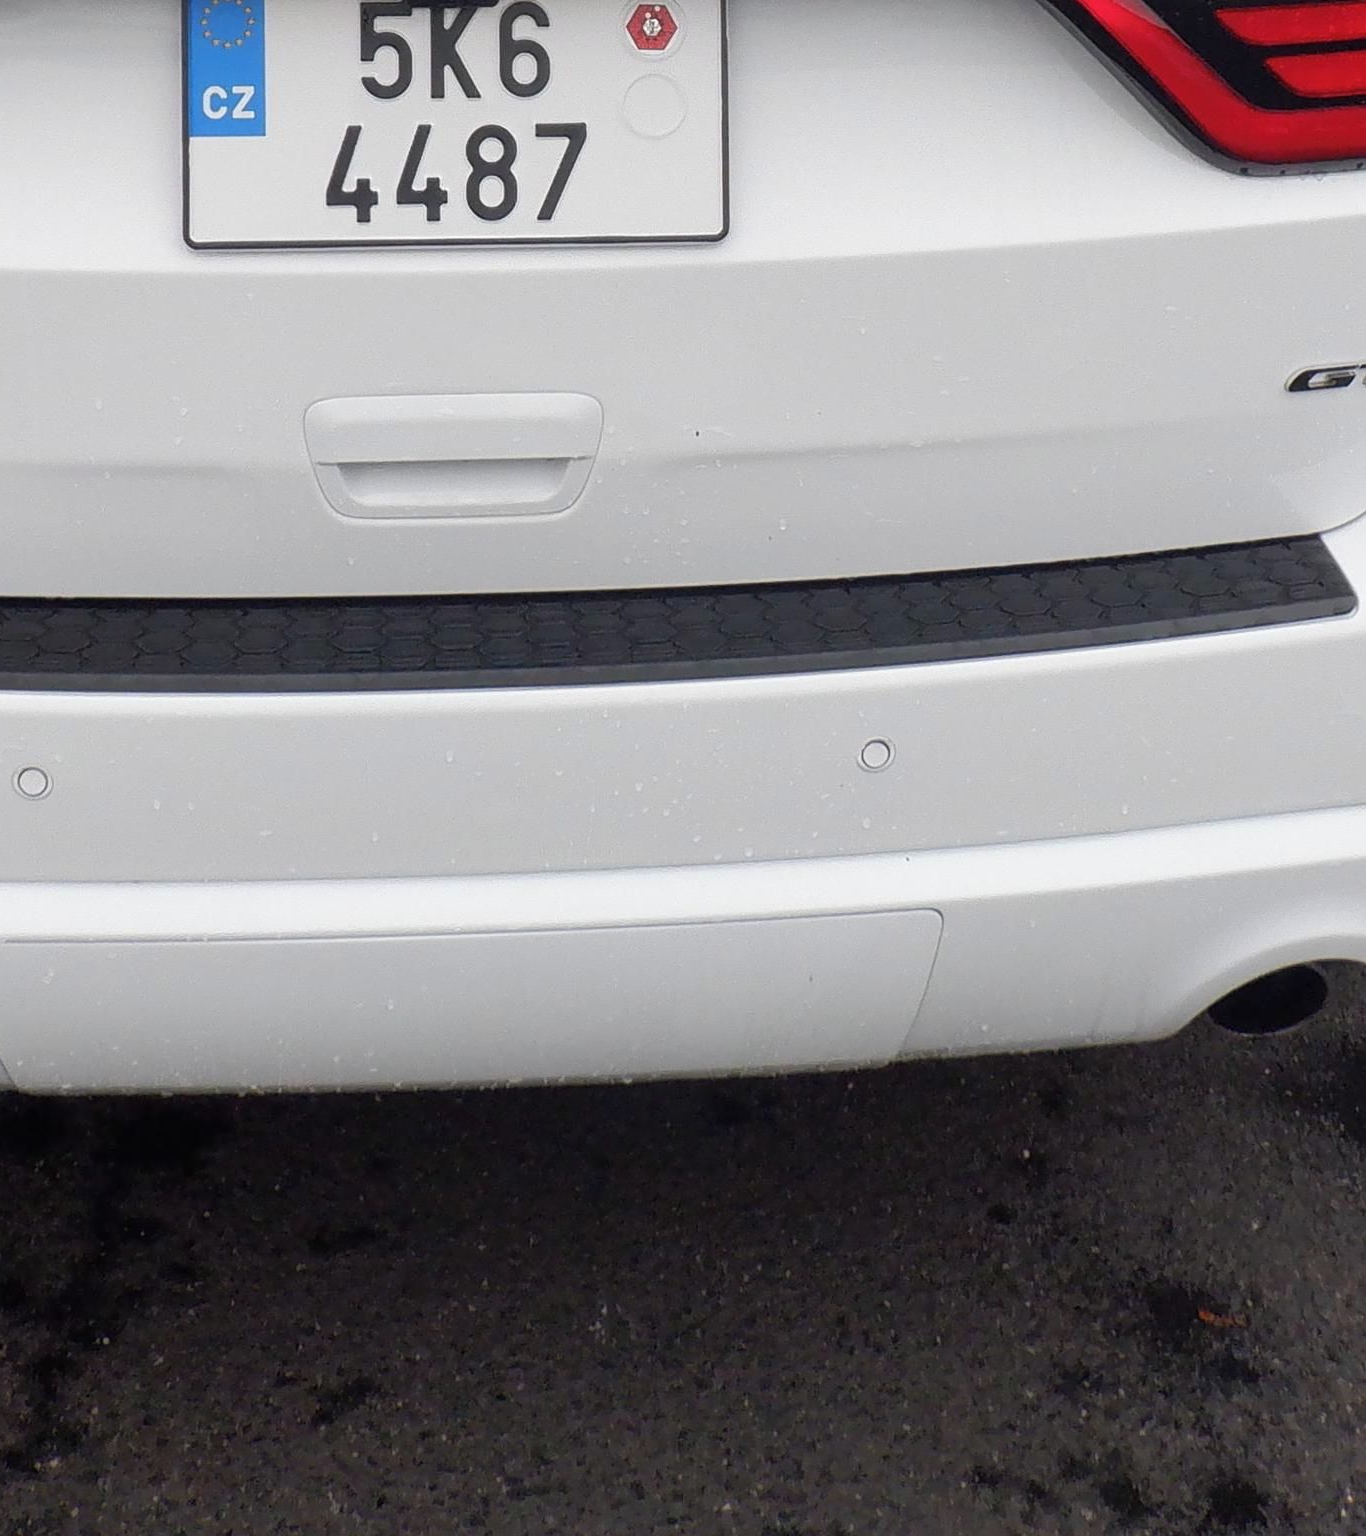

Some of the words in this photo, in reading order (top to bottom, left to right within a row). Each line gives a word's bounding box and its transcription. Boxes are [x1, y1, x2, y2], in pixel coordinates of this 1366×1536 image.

[360, 1, 551, 100] 5K6
[202, 85, 256, 120] CZ
[325, 122, 588, 224] 4487
